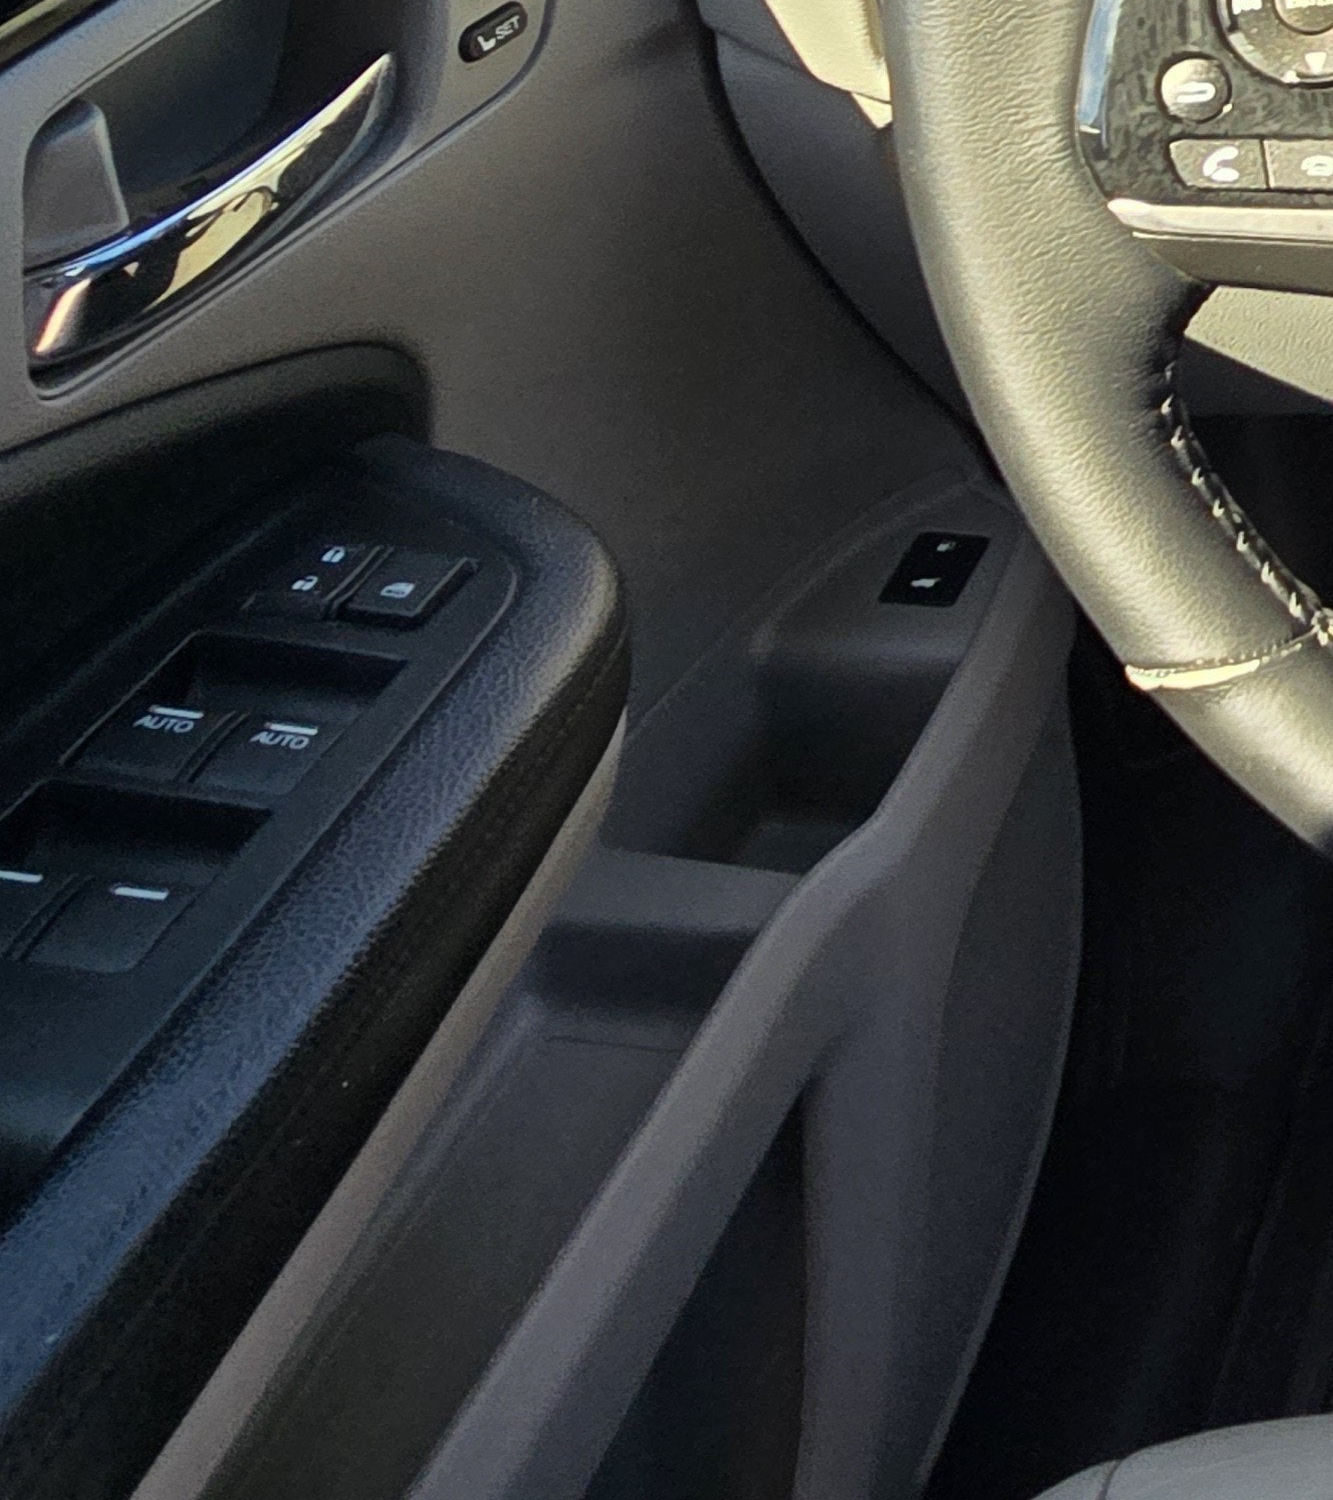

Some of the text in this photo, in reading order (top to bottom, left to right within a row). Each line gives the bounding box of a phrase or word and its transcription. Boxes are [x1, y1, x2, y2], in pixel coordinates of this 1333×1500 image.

[495, 15, 520, 39] SET
[133, 713, 196, 734] AUTO
[251, 729, 310, 750] AUTO
